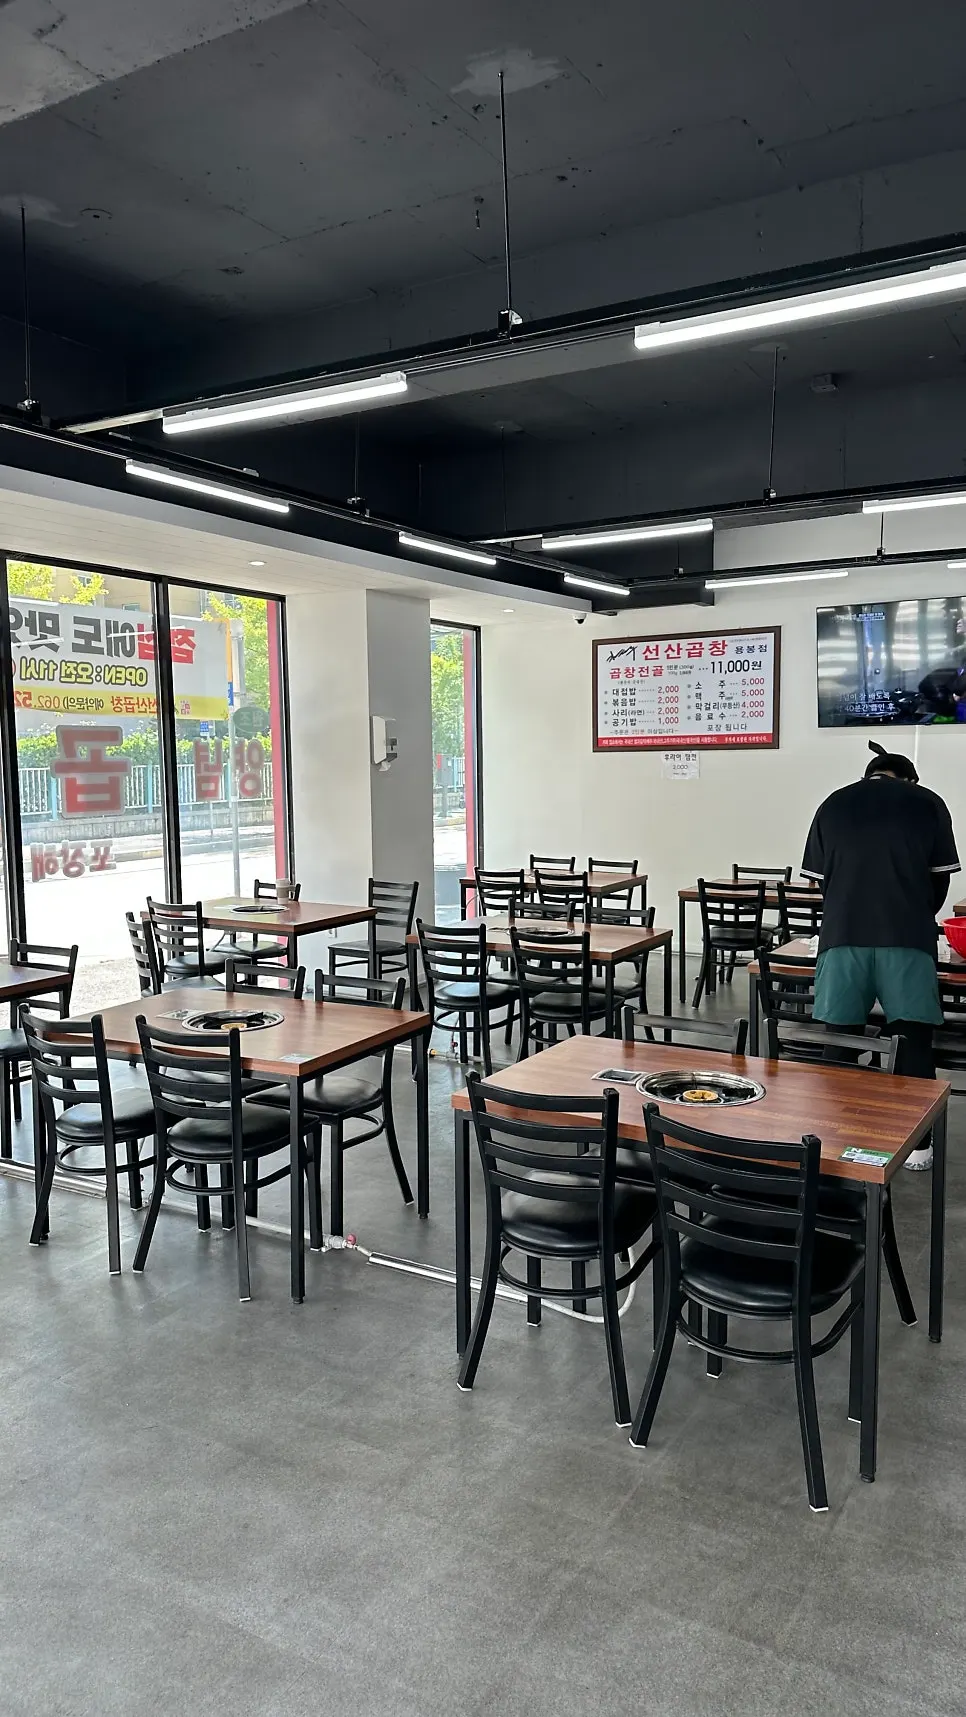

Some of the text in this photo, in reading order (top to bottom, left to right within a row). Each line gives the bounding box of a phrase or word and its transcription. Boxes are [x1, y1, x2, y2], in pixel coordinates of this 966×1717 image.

[642, 640, 728, 661] 선산곱창
[734, 644, 768, 654] 용봉점
[610, 665, 664, 680] 곱창전골
[710, 660, 762, 674] 11,000원
[742, 678, 764, 686] 5,000
[658, 686, 679, 694] 2,000
[742, 688, 764, 697] 5,000
[658, 696, 679, 704] 2,000
[741, 700, 764, 709] 4,000
[658, 706, 679, 715] 2,000
[741, 710, 764, 719] 2,000
[612, 716, 679, 727] 공기밥 1,000
[707, 723, 748, 732] 포장 됩니다
